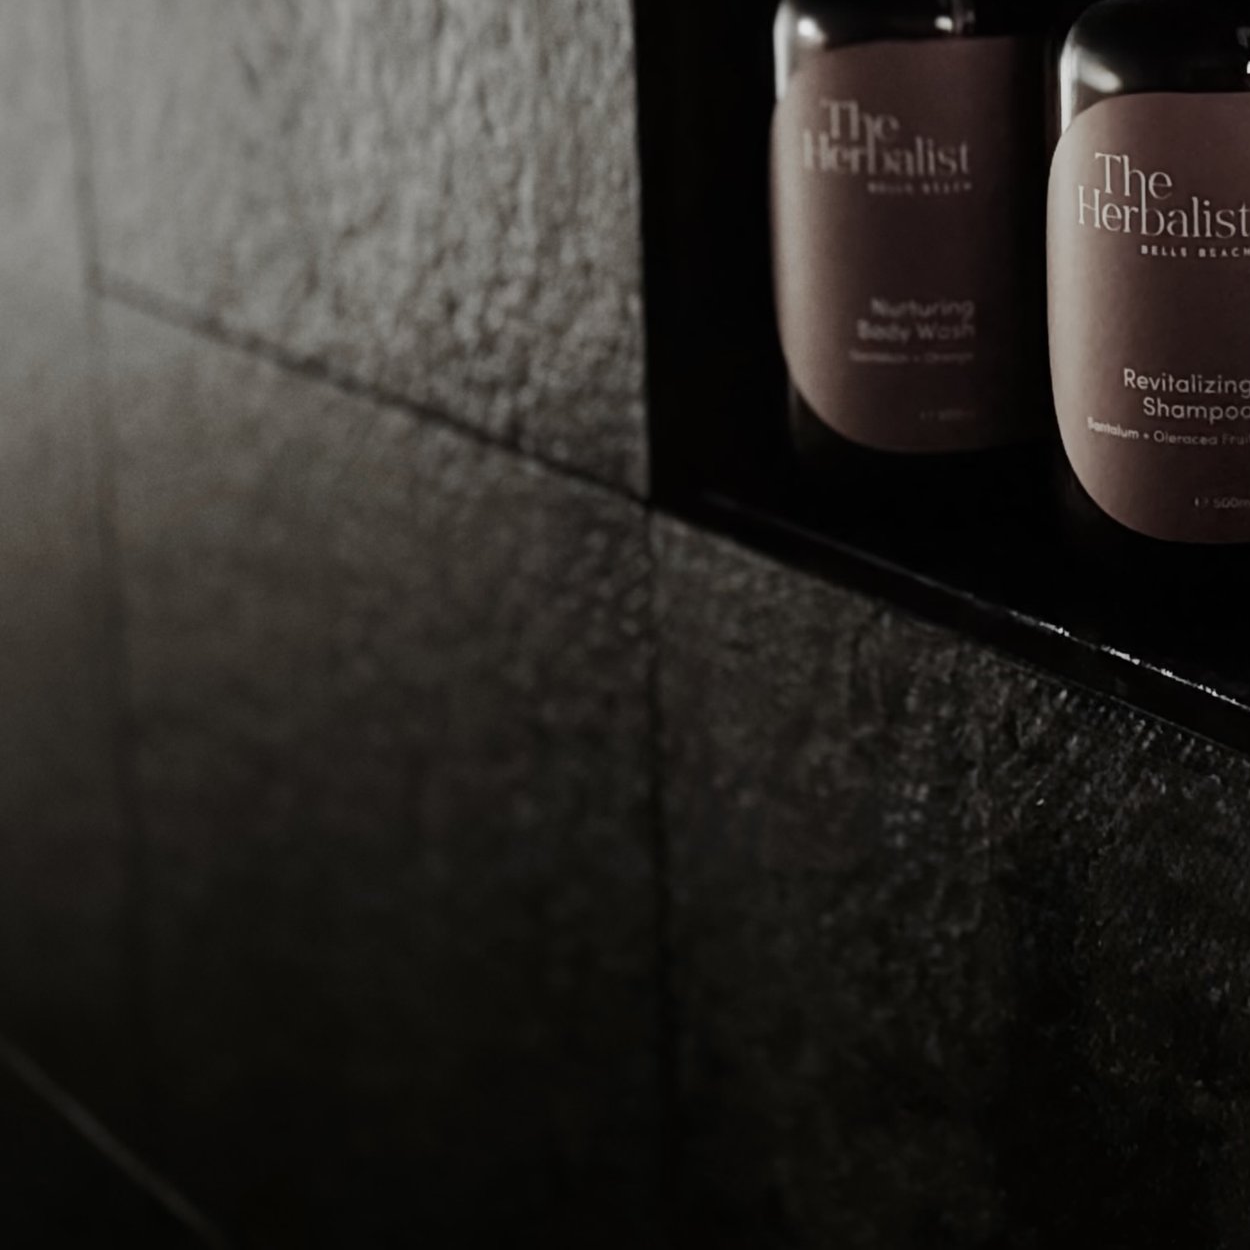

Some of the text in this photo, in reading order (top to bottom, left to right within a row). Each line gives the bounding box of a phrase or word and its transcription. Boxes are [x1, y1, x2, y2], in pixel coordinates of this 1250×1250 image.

[819, 97, 901, 143] The
[802, 128, 971, 178] Herbalist
[1095, 152, 1173, 200] The
